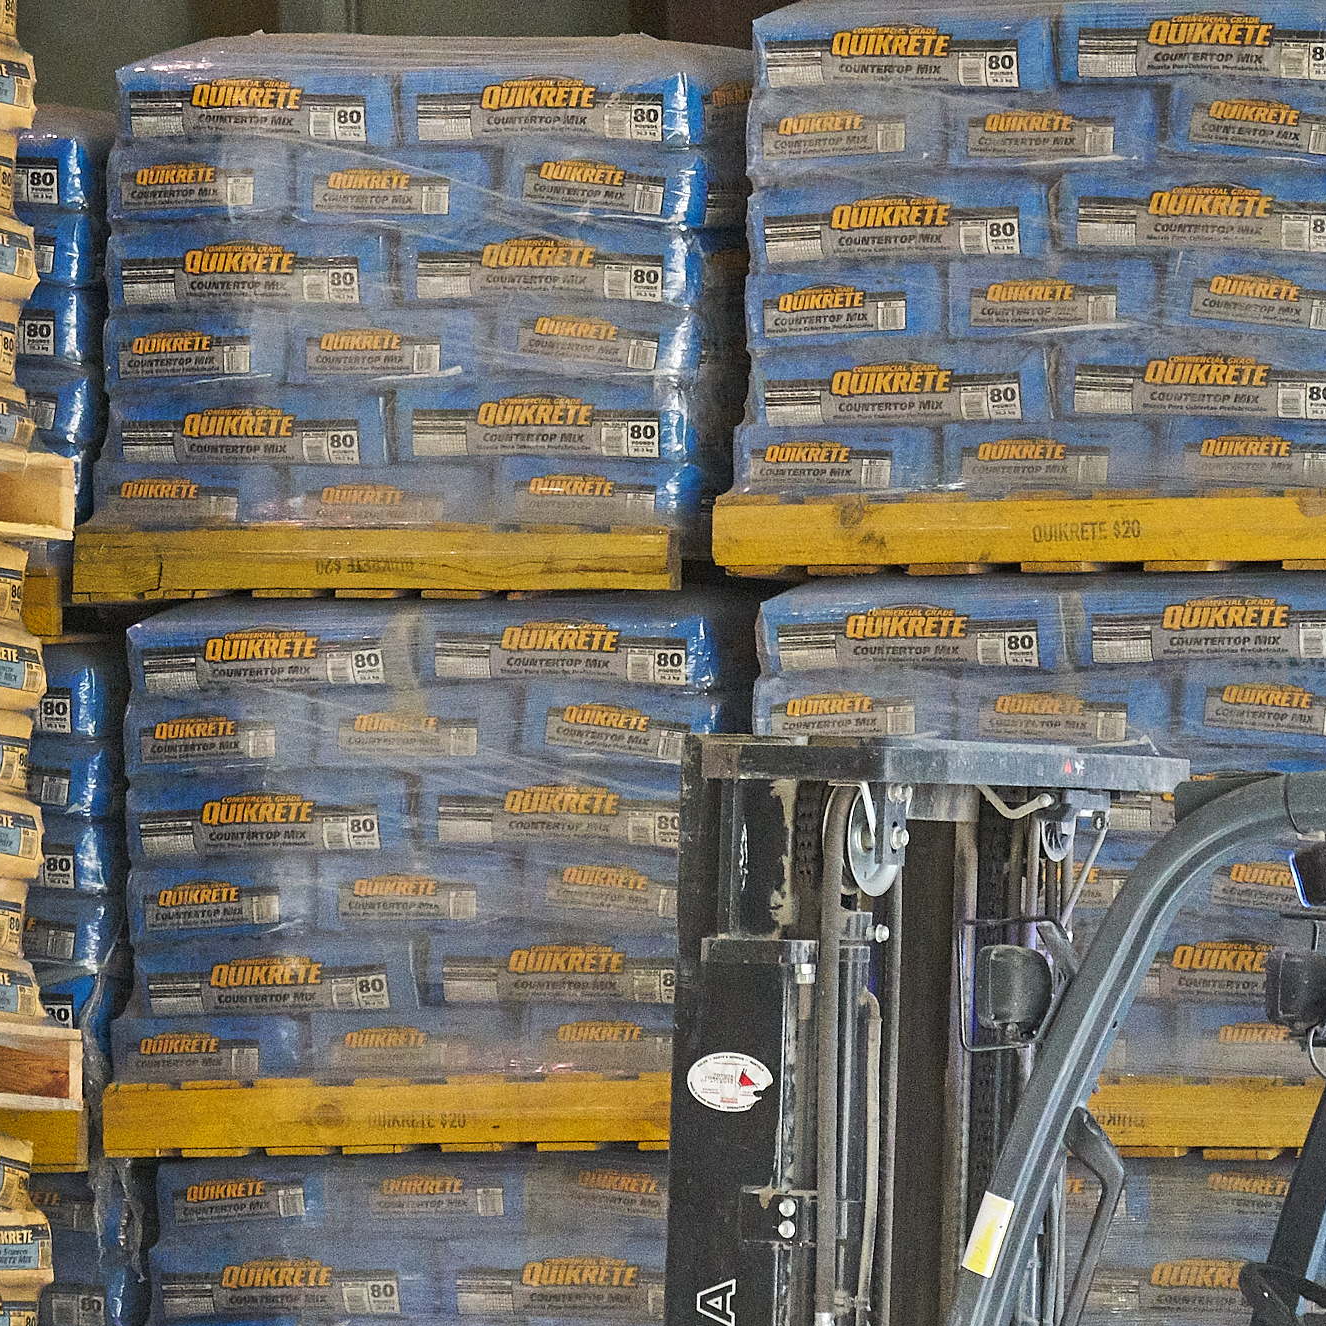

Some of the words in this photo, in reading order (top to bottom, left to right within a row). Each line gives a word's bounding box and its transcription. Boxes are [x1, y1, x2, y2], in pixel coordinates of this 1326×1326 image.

[1171, 15, 1229, 24] COMMERCIAL
[1231, 16, 1261, 24] GRADE
[1148, 20, 1274, 47] QUIKRETE
[831, 32, 952, 57] QUIKRETE
[988, 54, 1014, 70] 80
[1153, 53, 1234, 64] COUNTERTOP
[1237, 52, 1263, 64] MIX
[838, 64, 913, 75] COUNTERTOP
[916, 63, 941, 75] MIX
[191, 84, 303, 110] QUIKRETE
[481, 85, 596, 110] QUIKRETE
[337, 109, 361, 125] 80
[633, 108, 659, 124] 80
[985, 113, 1075, 132] QUIKRETE
[1209, 100, 1300, 126] QUIKRETE
[778, 114, 864, 135] QUIKRETE
[29, 172, 54, 187] 80
[136, 167, 216, 185] QUIKRETE
[328, 171, 410, 190] QUIKRETE
[540, 161, 626, 186] QUIKRETE
[533, 184, 600, 199] COUNTERTOP
[603, 190, 625, 200] MIX
[1148, 191, 1275, 217] QUIKRETE
[831, 205, 951, 230] QUIKRETE
[838, 235, 915, 246] COUNTERTOP
[918, 234, 943, 245] MIX
[989, 222, 1015, 238] 80
[185, 250, 295, 274] QUIKRETE
[482, 244, 596, 268] QUIKRETE
[1209, 276, 1300, 302] QUIKRETE
[779, 290, 865, 312] QUIKRETE
[535, 317, 618, 341] QUIKRETE
[132, 333, 210, 355] QUIKRETE
[320, 332, 402, 352] QUIKRETE
[831, 369, 952, 396] QUIKRETE
[1144, 359, 1268, 388] QUIKRETE
[1149, 390, 1228, 403] COUNTERTOP
[1232, 393, 1260, 405] MIX
[478, 400, 594, 428] QUIKRETE
[183, 412, 294, 439] QUIKRETE
[630, 424, 656, 440] 80
[330, 434, 355, 450] 80
[483, 433, 557, 445] COUNTERTOP
[561, 433, 584, 444] MIX
[1032, 523, 1107, 543] QUIKRETE
[1163, 602, 1289, 630] QUIKRETE
[846, 613, 968, 641] QUIKRETE
[205, 633, 318, 661] QUIKRETE
[501, 628, 619, 652] QUIKRETE
[1007, 634, 1034, 651] 80
[1169, 635, 1250, 648] COUNTERTOP
[1254, 635, 1281, 647] MIX
[354, 653, 380, 668] 80
[43, 700, 68, 717] 80
[203, 798, 313, 825] QUIKRETE
[369, 1282, 394, 1298] 80
